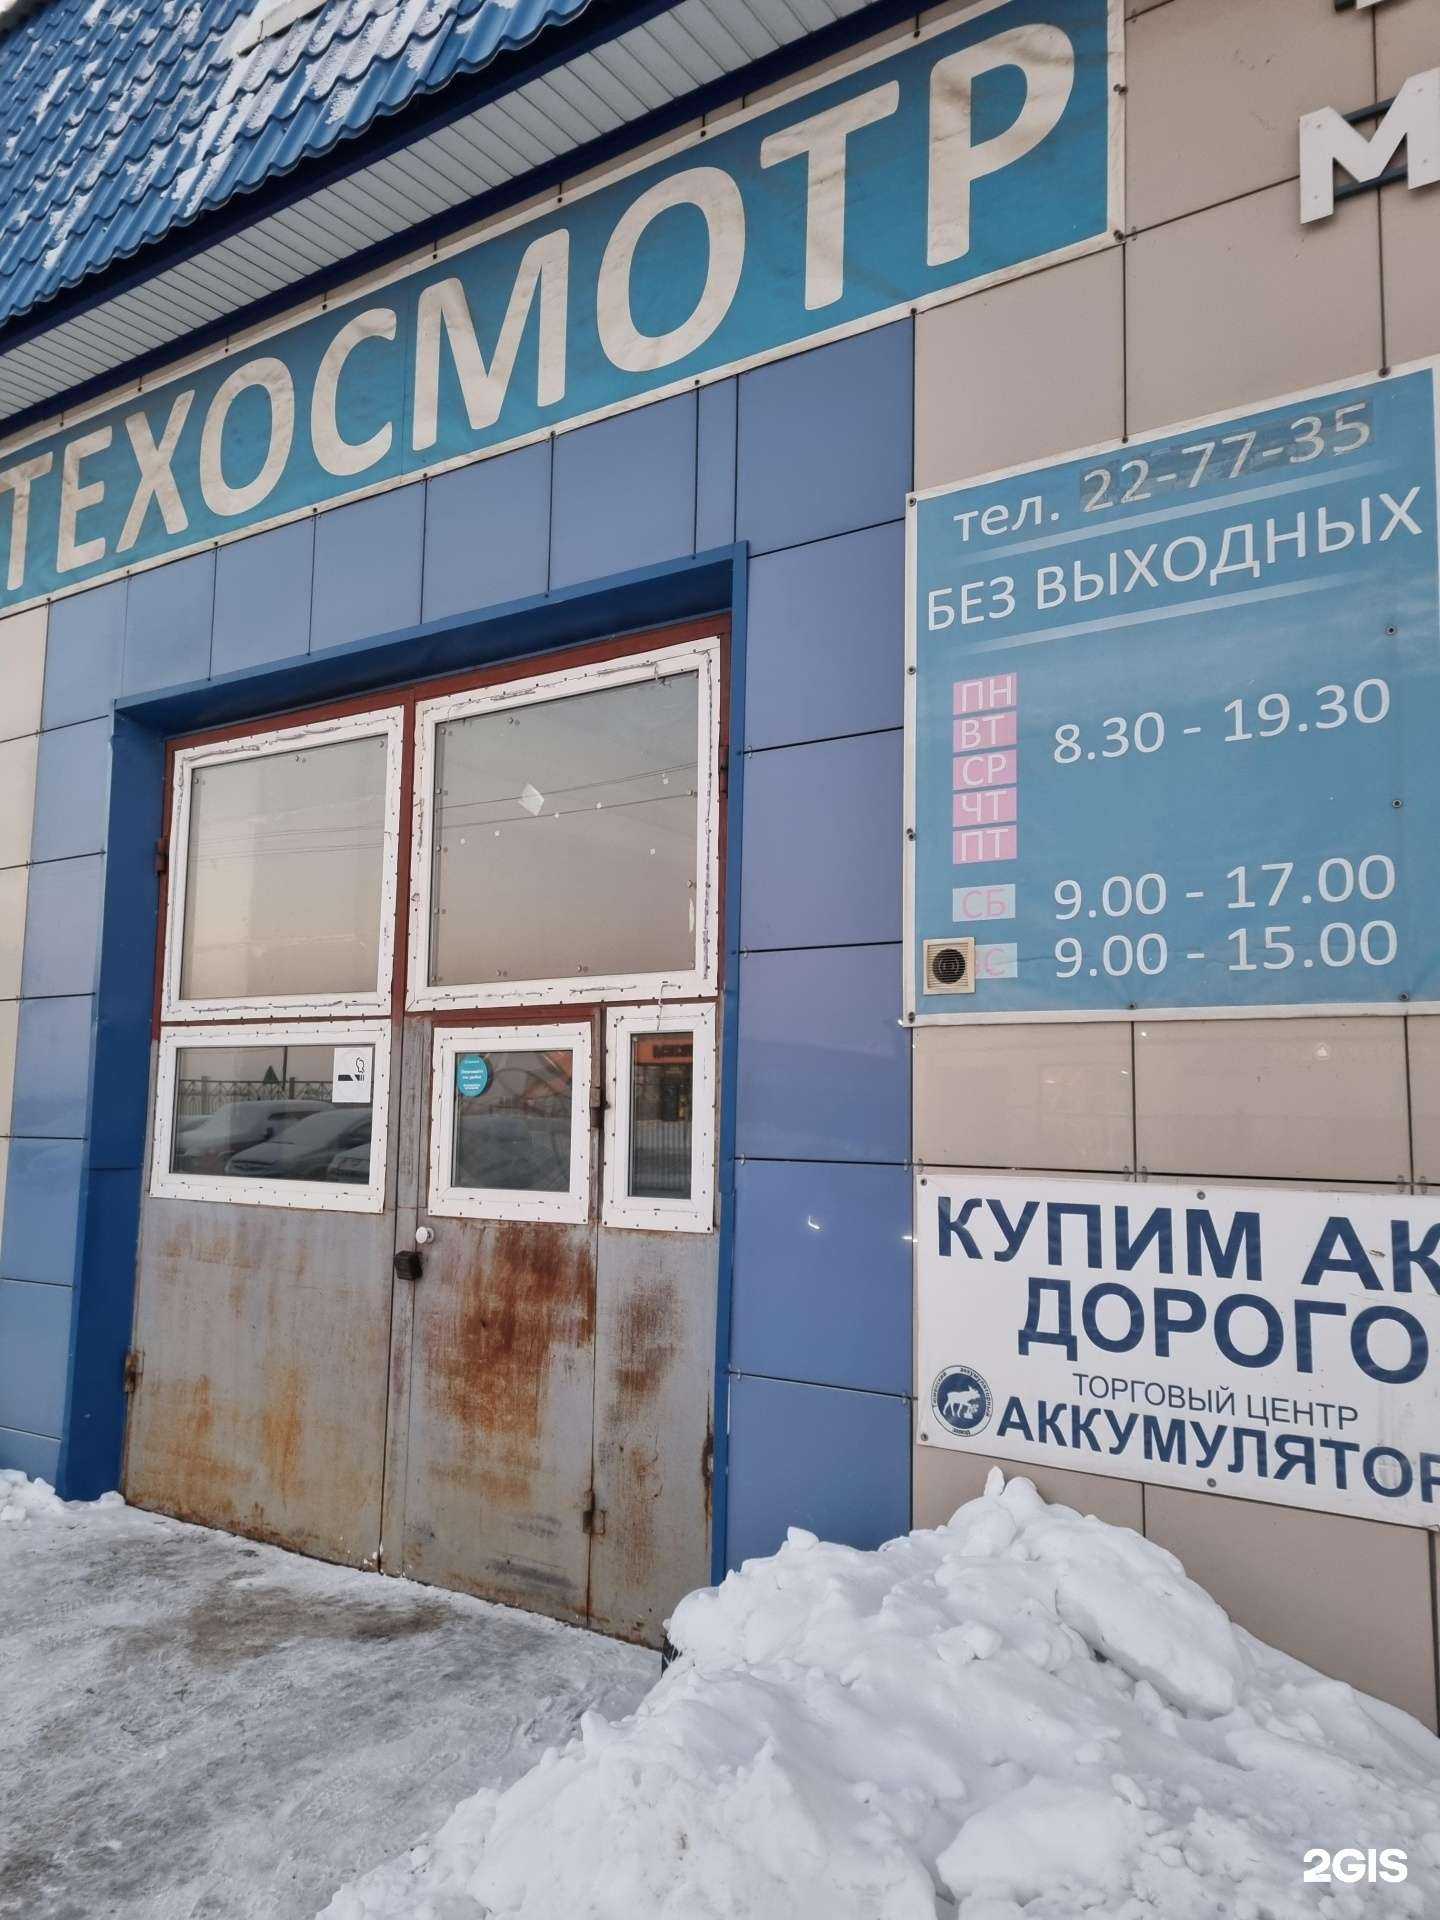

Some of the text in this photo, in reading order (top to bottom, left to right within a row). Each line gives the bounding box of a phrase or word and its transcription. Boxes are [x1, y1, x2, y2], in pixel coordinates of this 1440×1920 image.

[0, 23, 1074, 591] ТЕХОСМОТР
[953, 402, 1371, 542] тел. 22-77-35
[927, 486, 1423, 631] БЕЗ ВЫХОДНЫХ
[961, 675, 1013, 712] ПН
[1053, 711, 1166, 765] 8.30
[1224, 677, 1391, 743] 19.30
[961, 715, 1005, 749] ВТ
[962, 754, 1007, 786] СР
[962, 790, 1007, 822] ЧТ
[961, 828, 1009, 861] ПТ
[961, 888, 1007, 919] СБ
[1053, 872, 1168, 921] 9.00
[1226, 854, 1396, 910] 17.00
[975, 946, 1007, 977] С
[1054, 931, 1168, 979] 9.00
[1227, 920, 1399, 972] 15.00
[937, 1196, 1263, 1282] КУПИМ
[1017, 1277, 1430, 1385] ДОРОГО
[1073, 1372, 1359, 1431] ТОРГОВЫЙ ЦЕНТР
